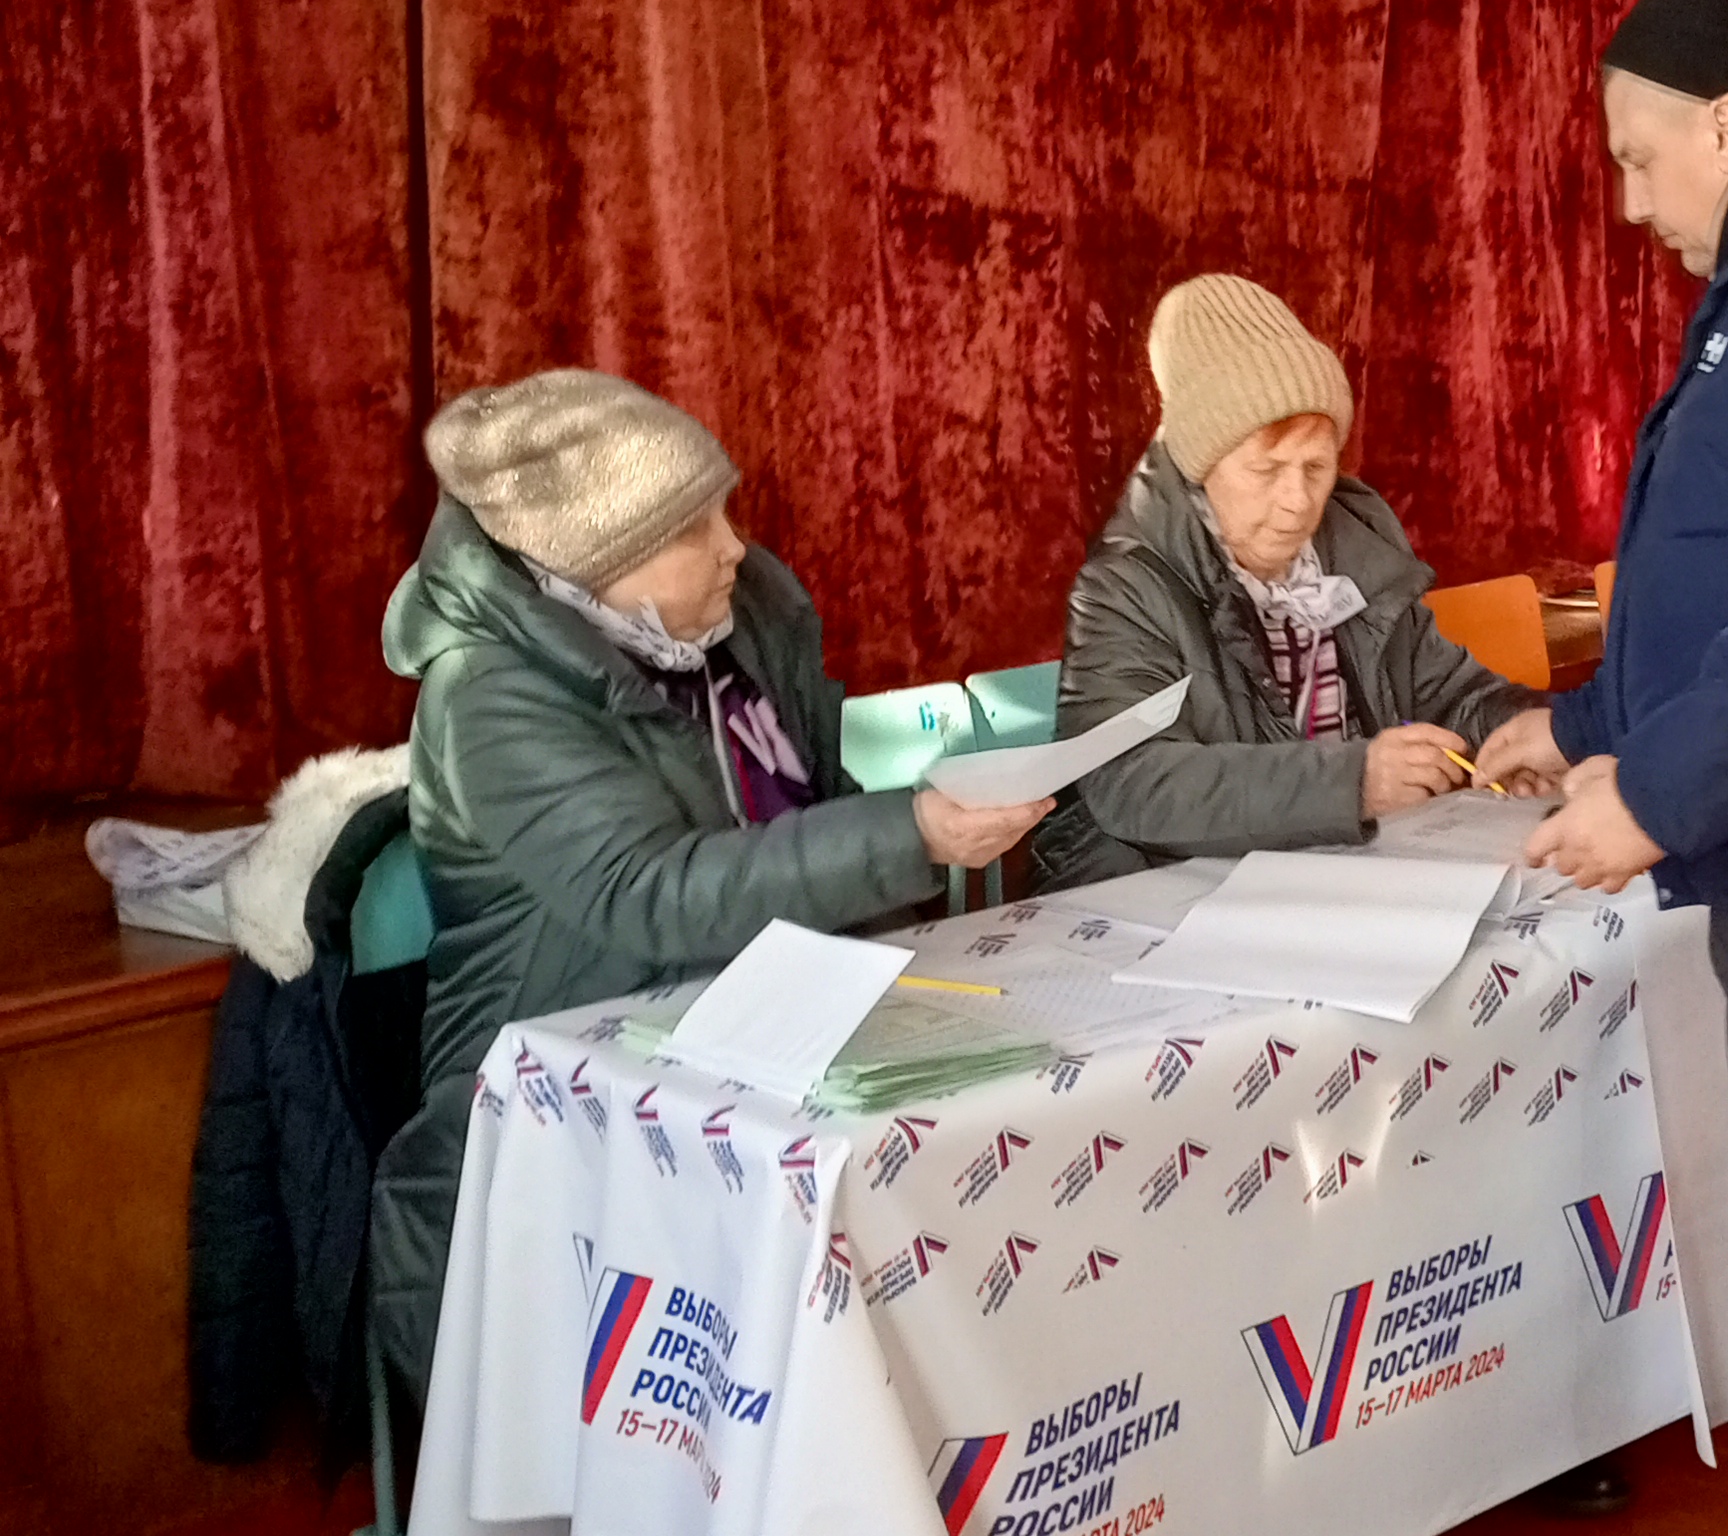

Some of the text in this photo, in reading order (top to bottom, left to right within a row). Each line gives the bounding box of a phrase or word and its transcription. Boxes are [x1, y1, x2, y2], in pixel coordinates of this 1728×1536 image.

[1374, 1261, 1523, 1347] ПРЕЗИДЕНТА
[1386, 1235, 1492, 1302] ВЫБОРЫ
[665, 1286, 738, 1361] ВЫБОРЫ
[1364, 1324, 1462, 1391] РОССИИ
[630, 1368, 712, 1434] РОССИИ
[1405, 1361, 1462, 1408] МАРТА
[1465, 1342, 1505, 1383] 2024
[1024, 1372, 1143, 1457] ВЫБОРЫ
[1005, 1400, 1180, 1503] ПРЕЗИДЕНТА
